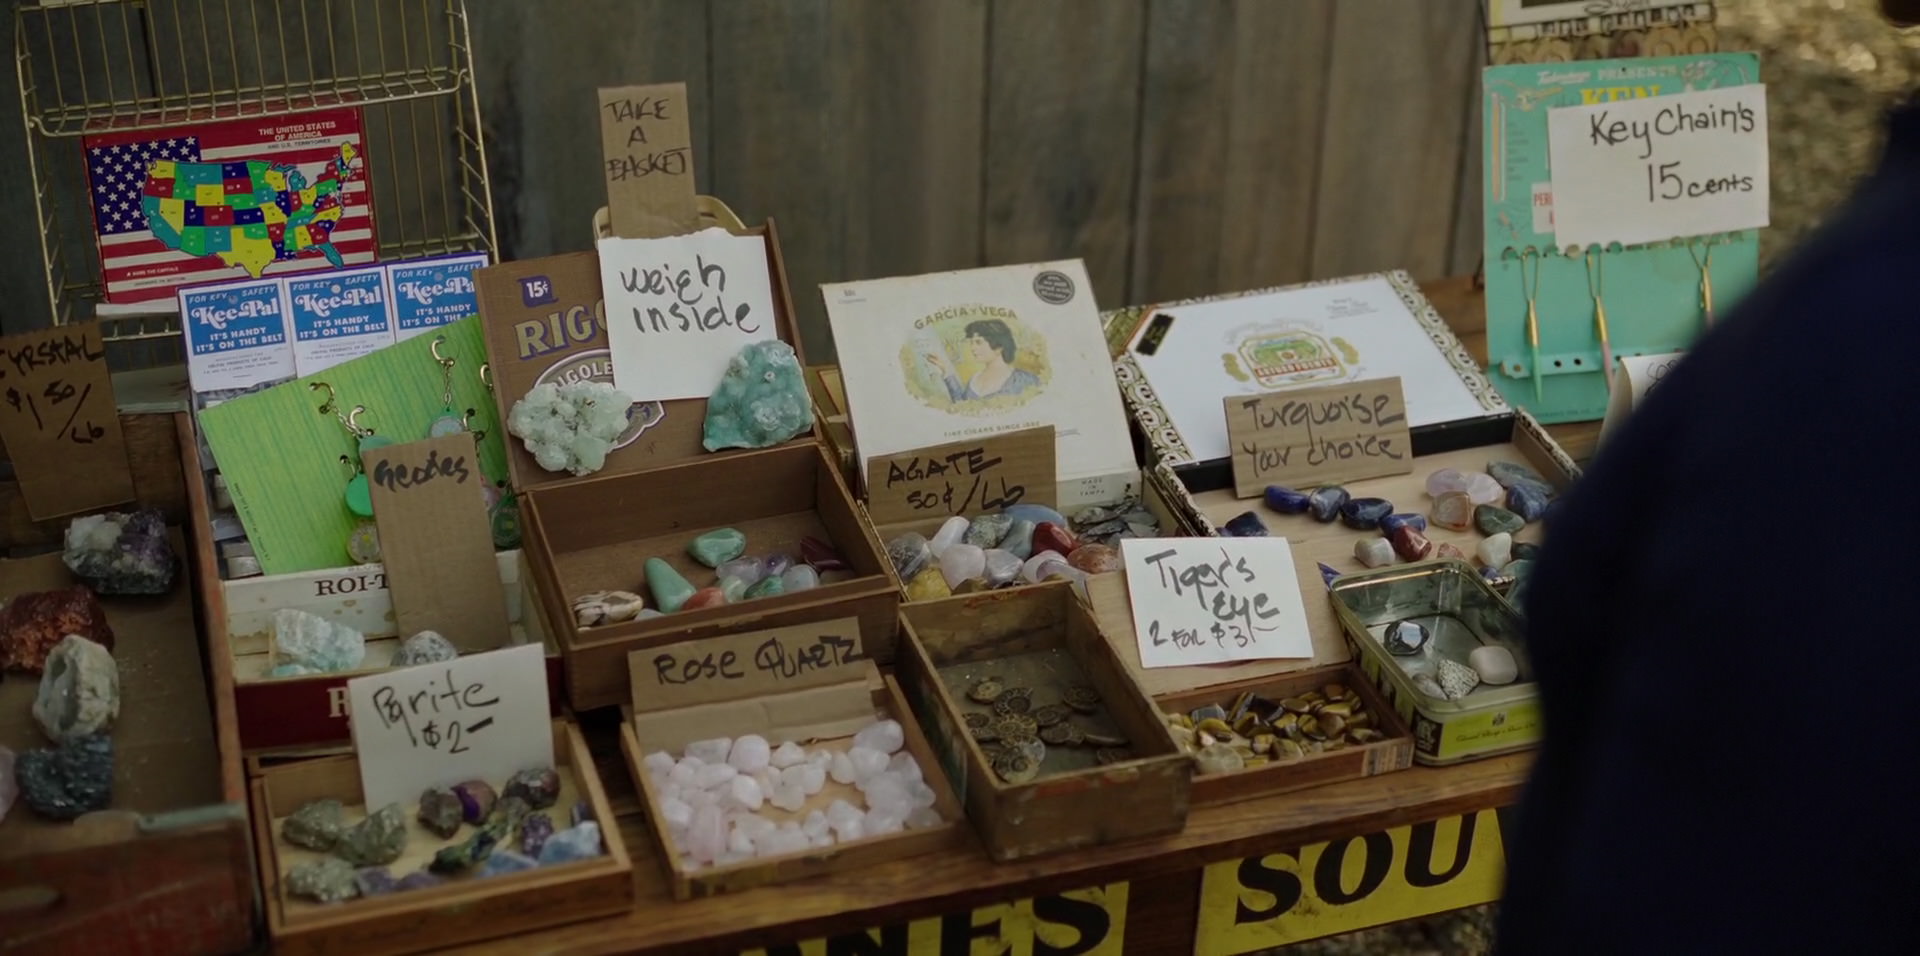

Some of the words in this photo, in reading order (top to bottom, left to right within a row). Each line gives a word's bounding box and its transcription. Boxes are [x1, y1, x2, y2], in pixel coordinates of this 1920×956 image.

[603, 97, 671, 122] TAKE
[258, 127, 273, 135] THE
[276, 124, 304, 133] UNITED
[306, 121, 337, 129] STATES
[288, 130, 322, 140] AMERICA
[627, 126, 648, 148] A
[606, 147, 690, 181] BASKET
[1649, 161, 1683, 203] 15
[1688, 174, 1753, 198] cents
[447, 263, 480, 273] SAFETY
[293, 283, 310, 291] FOR
[313, 281, 331, 289] KEY
[345, 274, 378, 285] SAFETY
[619, 254, 726, 305] weigh
[189, 295, 206, 304] FOR
[241, 286, 276, 297] SAFETY
[526, 281, 549, 298] 15¢
[436, 303, 471, 314] HANDY
[633, 295, 761, 333] inside
[313, 320, 331, 328] IT'S
[334, 315, 369, 326] HANDY
[425, 316, 440, 325] ON
[914, 307, 968, 330] GARCIA
[979, 306, 1018, 320] VEGA
[210, 332, 228, 341] IT'S
[231, 327, 266, 338] HANDY
[300, 330, 318, 338] IT'S
[322, 328, 338, 336] ON
[342, 325, 360, 333] THE
[364, 322, 385, 331] BELT
[196, 343, 214, 352] IT'S
[219, 340, 235, 349] ON
[239, 337, 257, 346] THE
[262, 334, 283, 343] BELT
[1243, 394, 1404, 449] Turquoise
[1307, 434, 1403, 466] choice
[887, 448, 1002, 488] AGATE
[1149, 620, 1168, 647] 2
